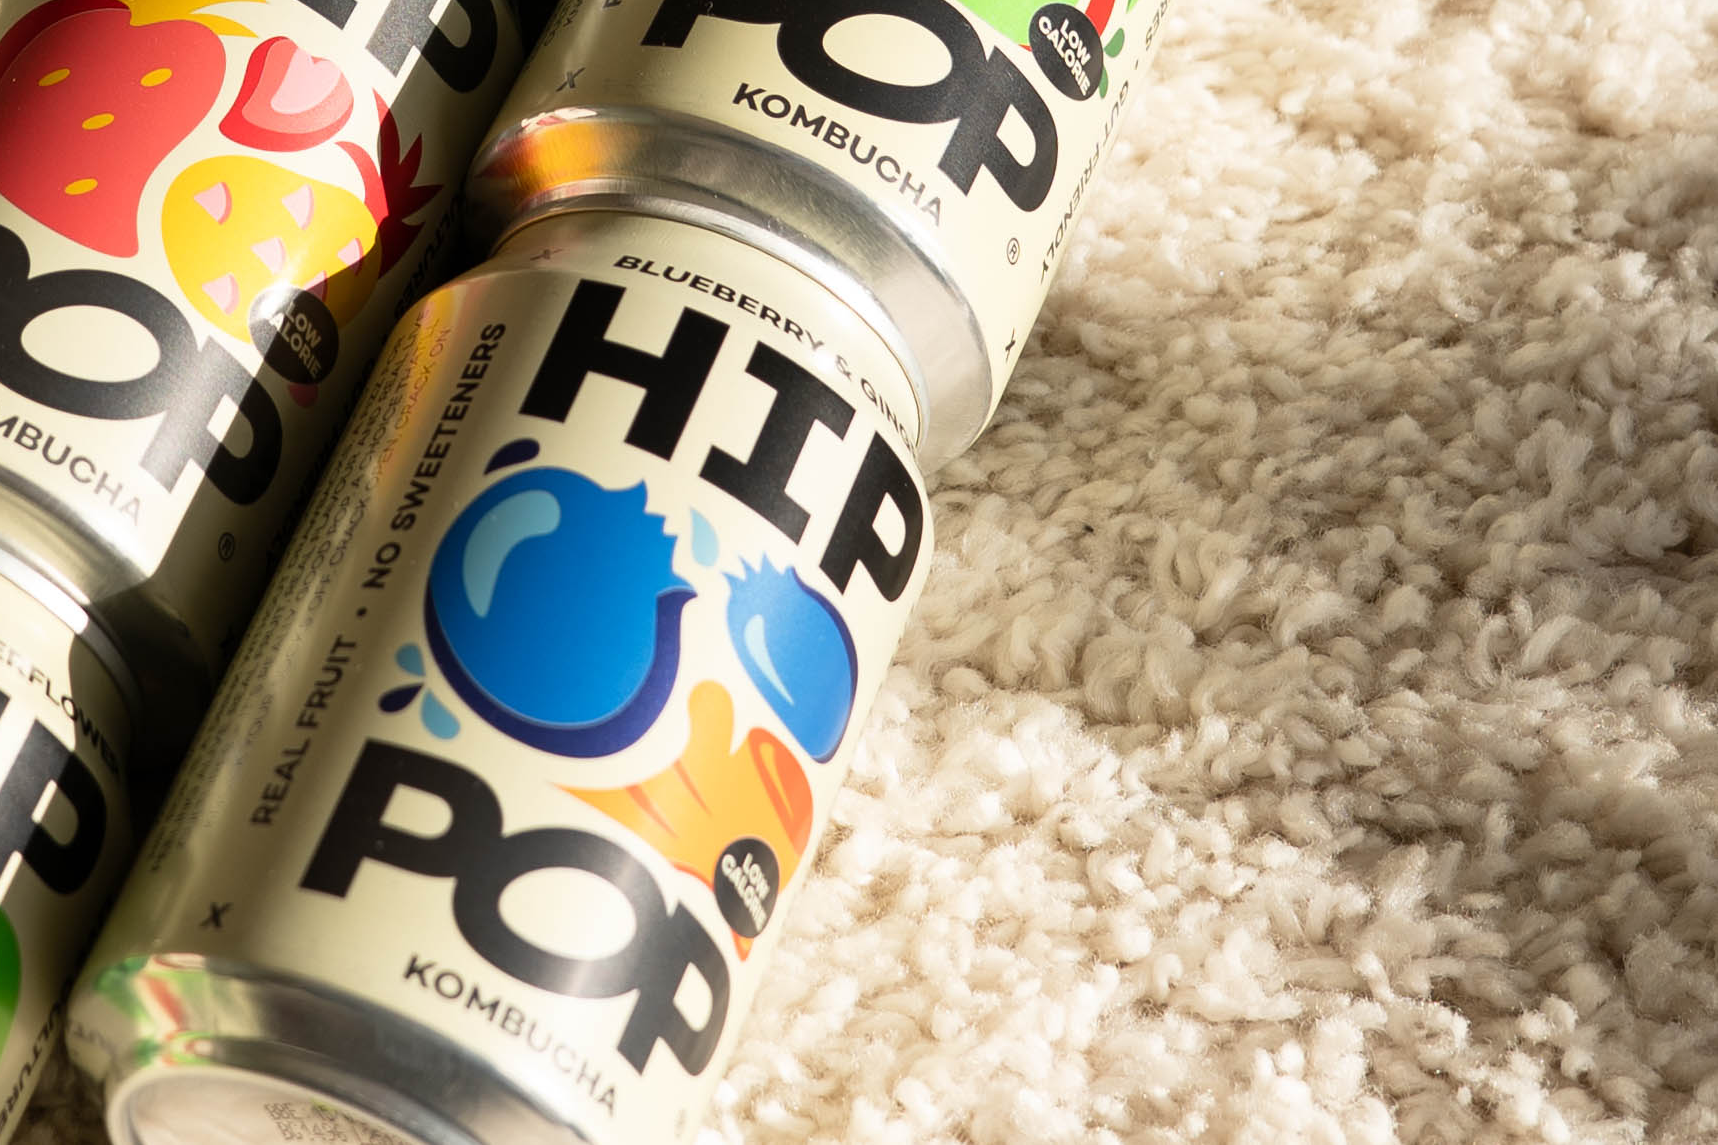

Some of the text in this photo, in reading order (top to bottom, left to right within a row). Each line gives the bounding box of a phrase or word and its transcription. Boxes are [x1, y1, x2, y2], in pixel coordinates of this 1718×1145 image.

[1037, 15, 1092, 96] CALORIE
[1059, 17, 1092, 67] LOW
[732, 82, 944, 227] KOMBUCHA
[1098, 82, 1130, 149] GUT
[1039, 147, 1102, 286] FRIENDLY
[265, 309, 323, 379] ALORIE
[285, 301, 322, 349] LOW
[613, 254, 920, 457] BLUEBERRY & GING
[518, 277, 924, 602] HIP
[250, 321, 508, 828] REAL FRUIT NO SWEETENERS
[299, 738, 730, 1076] POP
[742, 852, 771, 901] LOW
[403, 953, 618, 1118] KOMBUCHA
